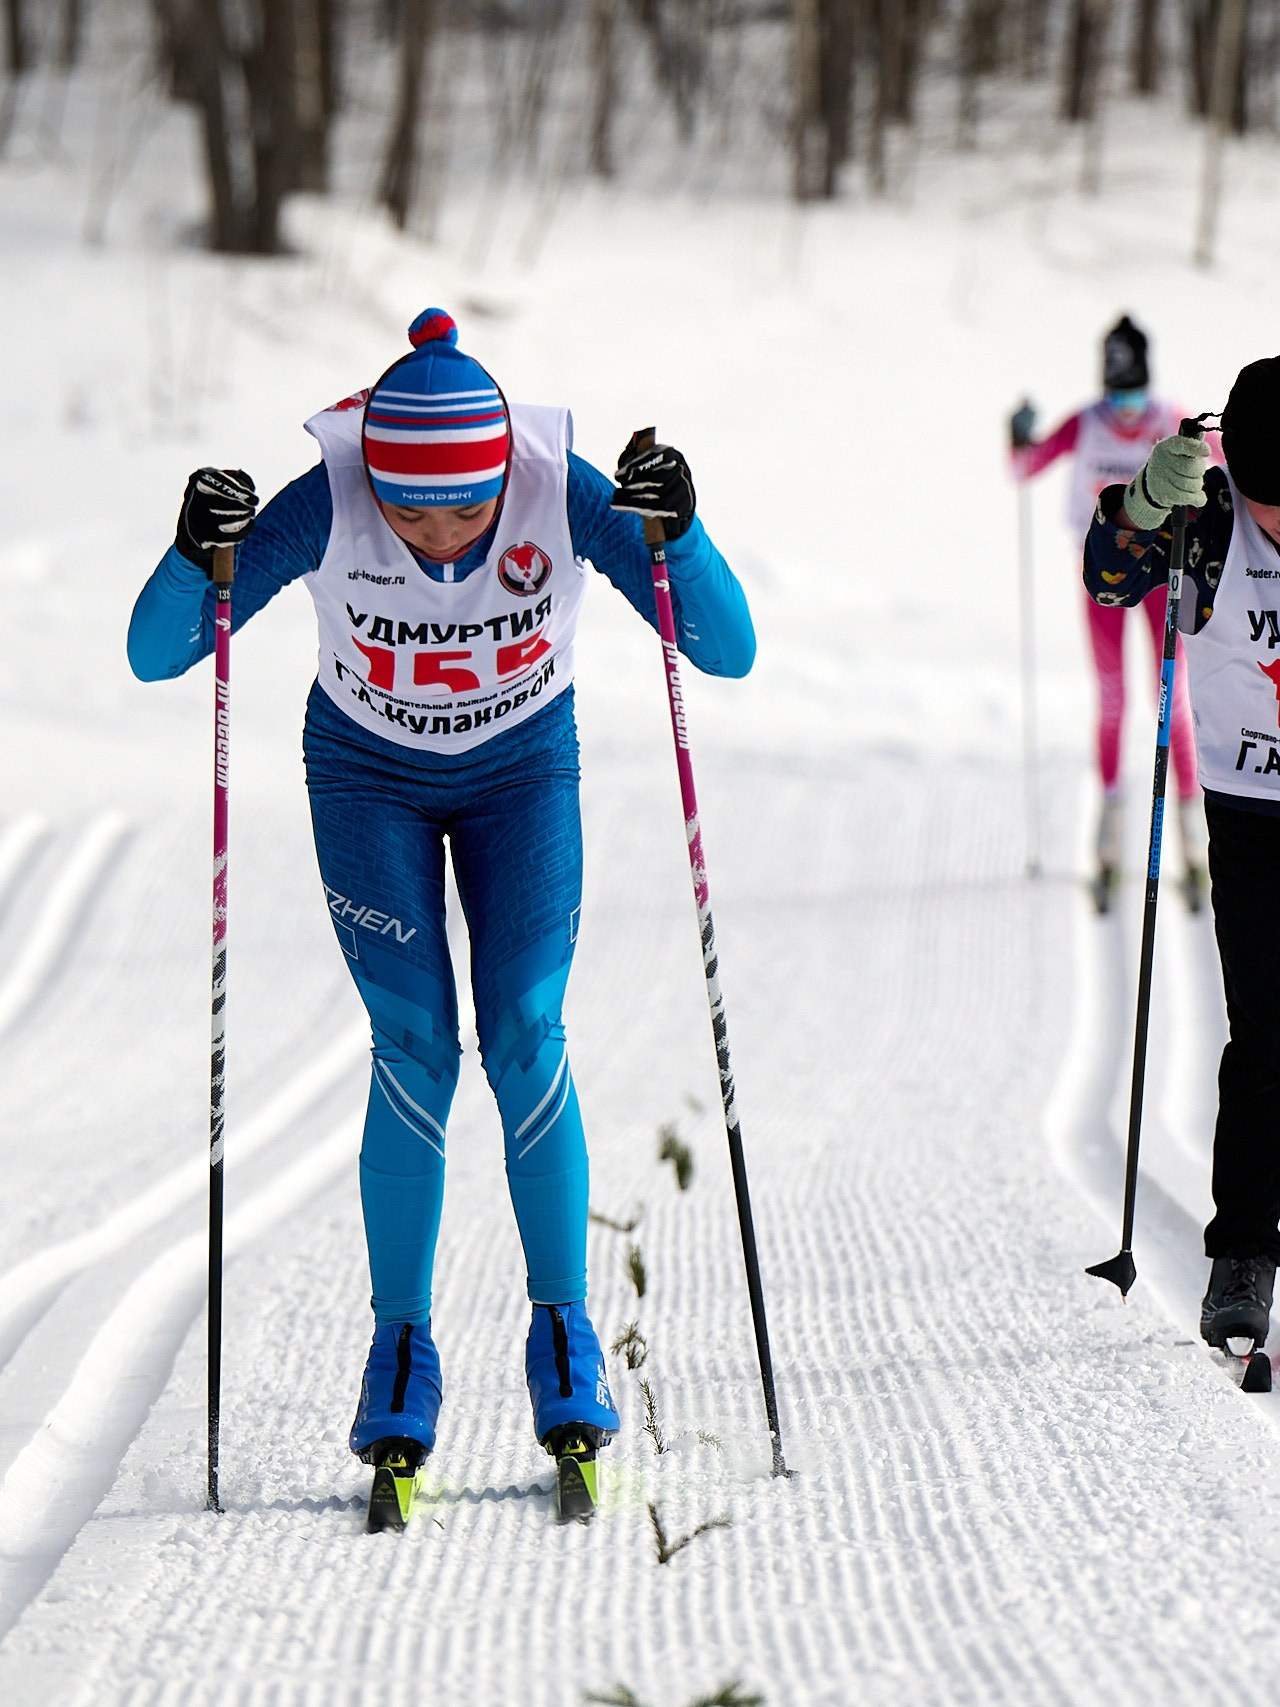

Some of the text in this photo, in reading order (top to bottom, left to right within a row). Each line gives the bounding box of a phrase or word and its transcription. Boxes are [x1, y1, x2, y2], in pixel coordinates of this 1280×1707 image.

[402, 491, 472, 501] NORDSKI
[218, 589, 231, 600] 135
[346, 593, 552, 647] УДМУРТИЯ
[324, 884, 417, 944] ZHEN
